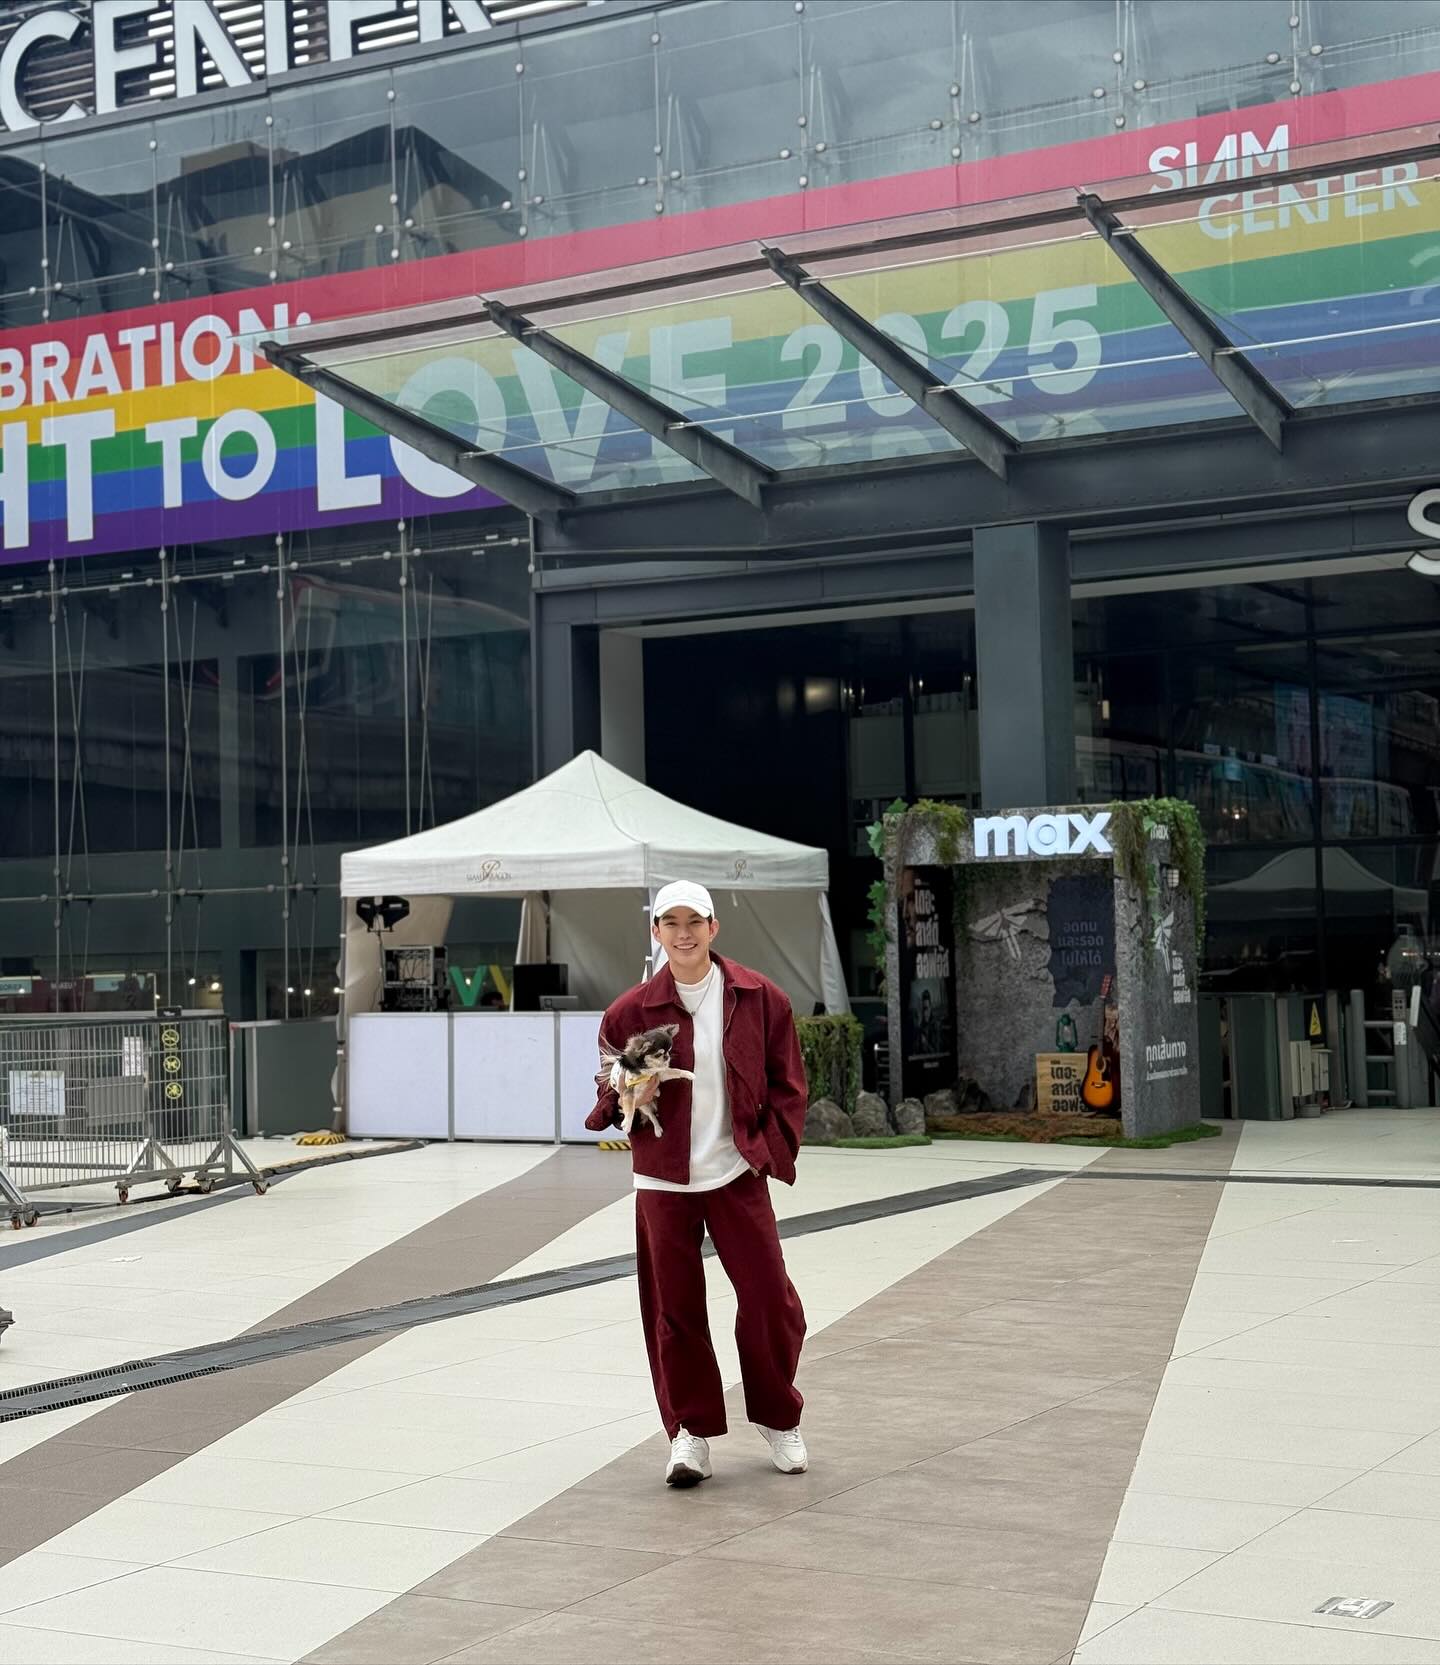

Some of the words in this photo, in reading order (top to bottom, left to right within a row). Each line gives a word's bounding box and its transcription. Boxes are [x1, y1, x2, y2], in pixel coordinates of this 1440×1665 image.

[1149, 124, 1289, 194] SIAM
[1198, 162, 1421, 240] CENTER
[145, 408, 277, 508] TO
[315, 316, 735, 512] LOVE
[780, 284, 1102, 431] 2025
[974, 812, 1114, 857] max
[1058, 935, 1104, 946] และรอด
[1050, 1066, 1077, 1079] เดอะ
